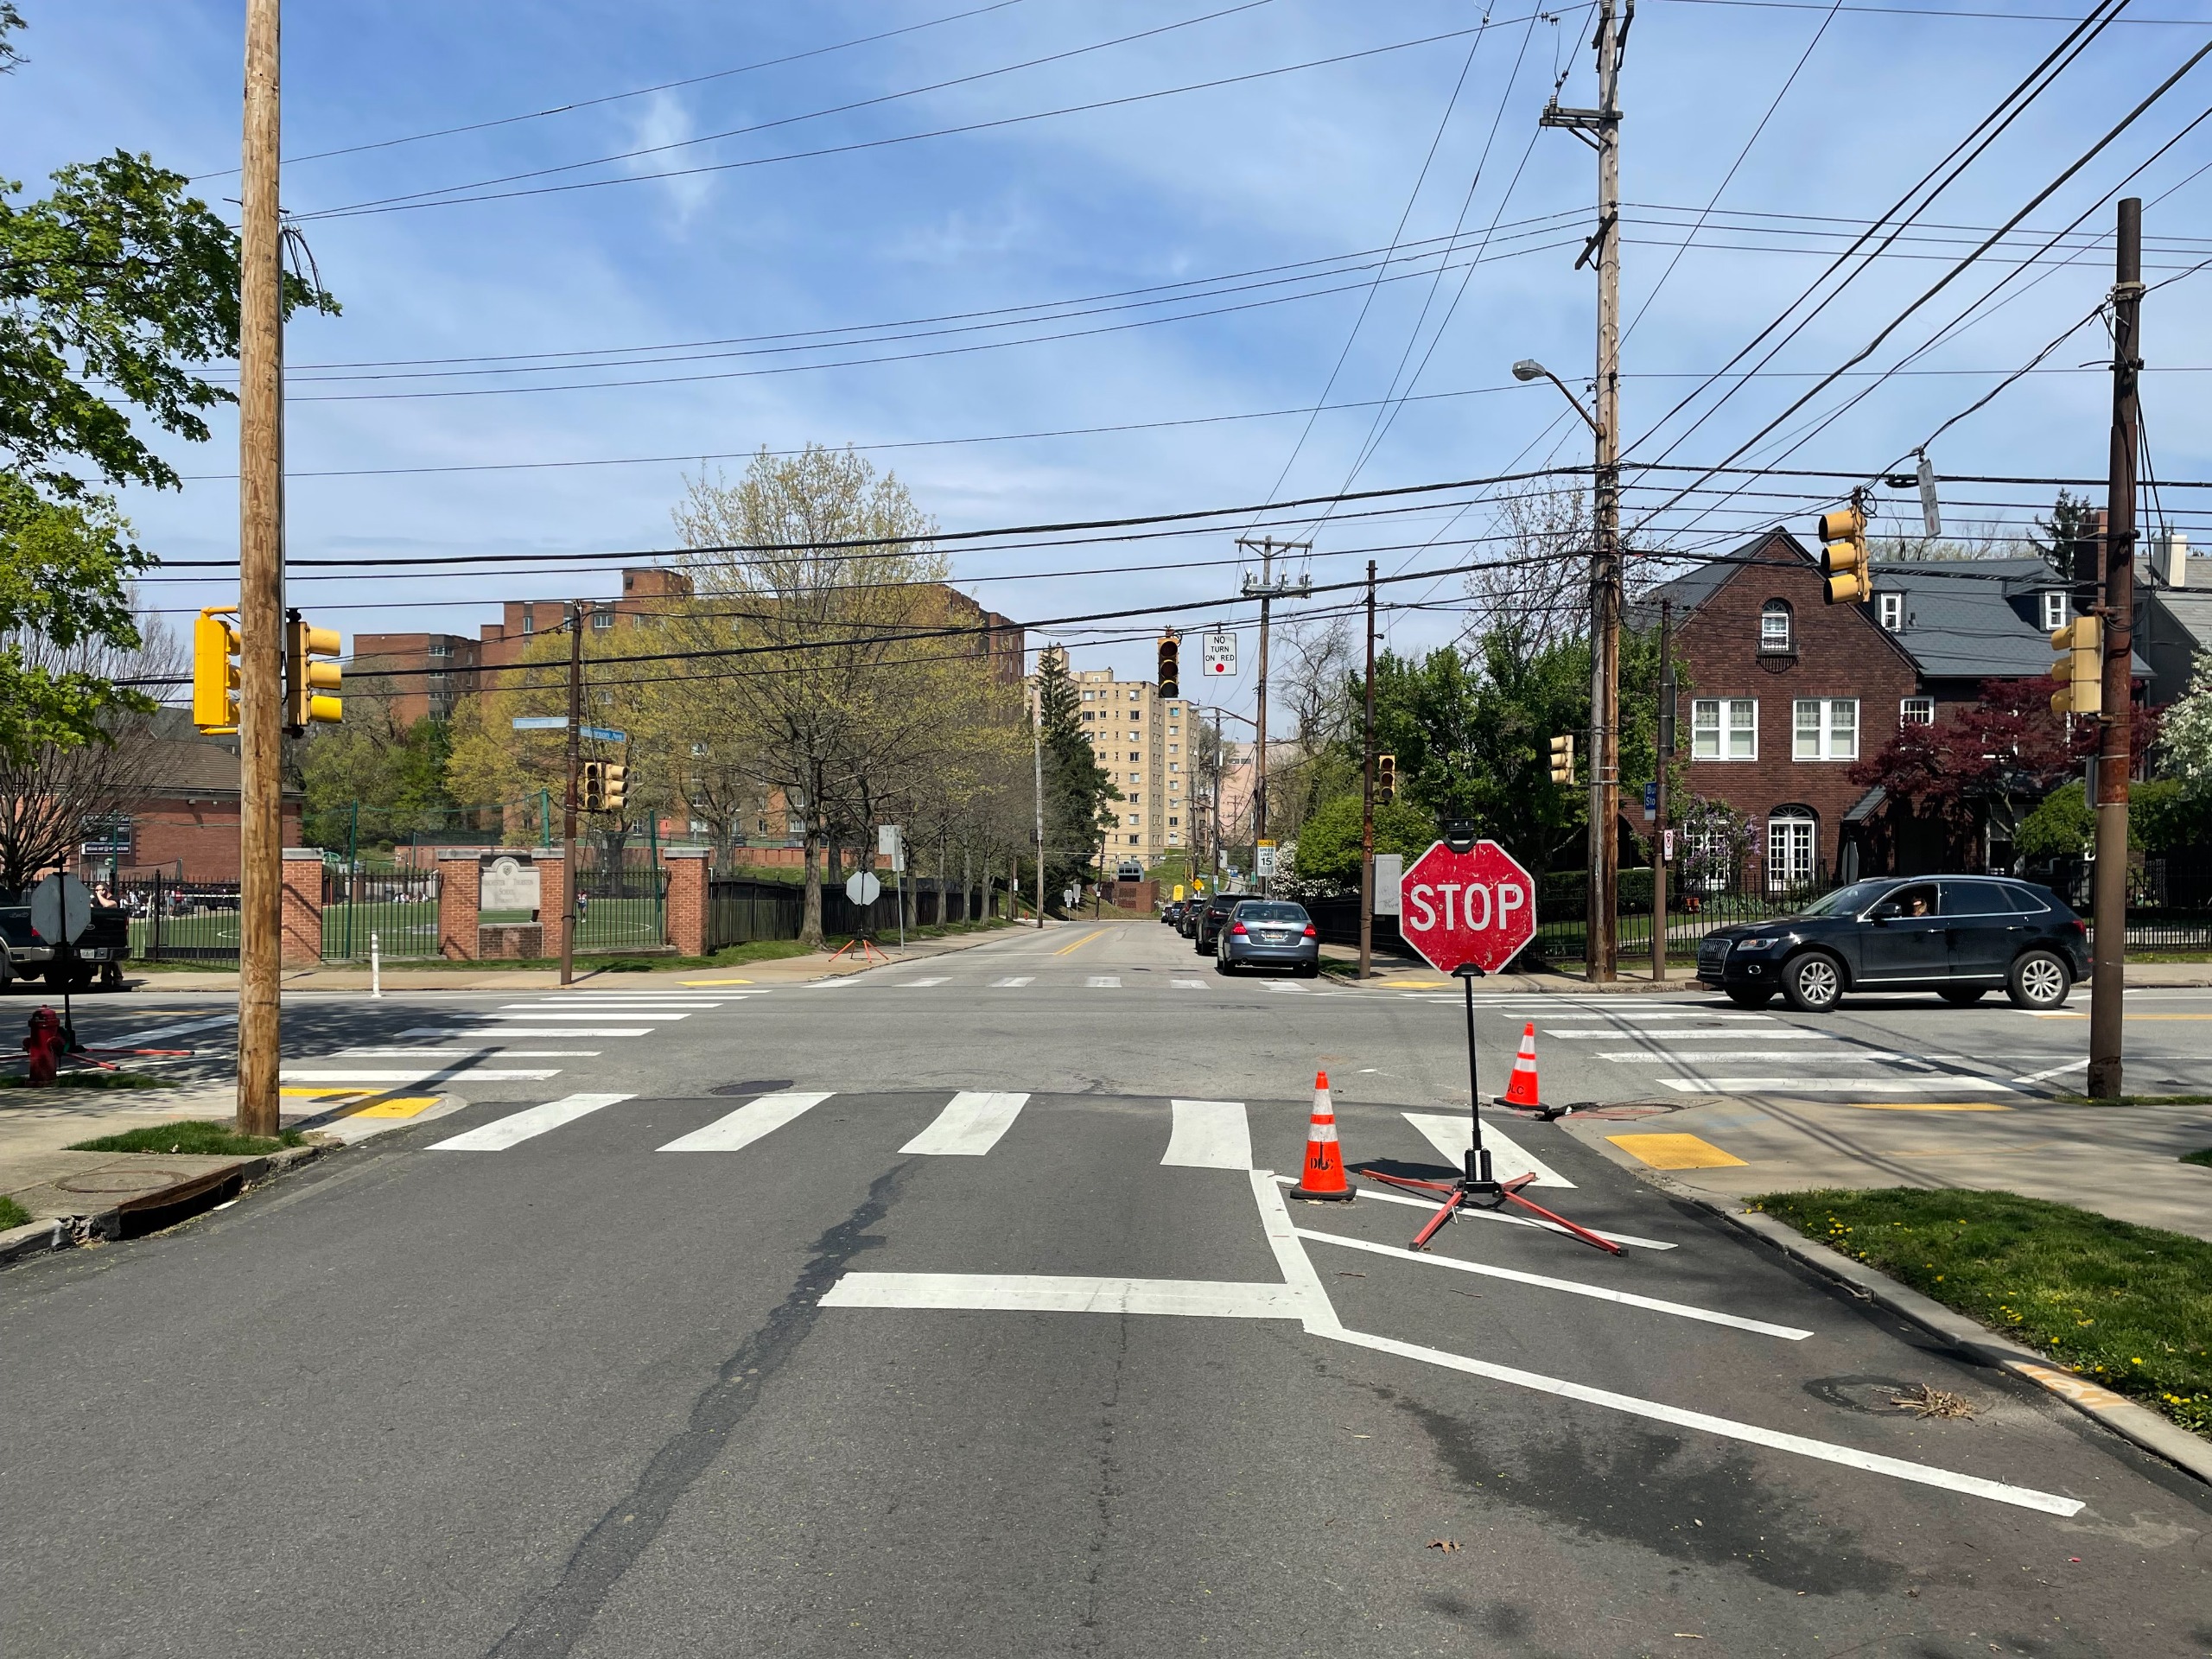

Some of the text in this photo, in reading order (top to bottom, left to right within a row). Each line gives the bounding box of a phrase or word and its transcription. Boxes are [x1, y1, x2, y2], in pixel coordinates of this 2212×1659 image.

[1648, 785, 1656, 794] Bu
[1261, 857, 1273, 866] 15
[1409, 882, 1524, 931] STOP
